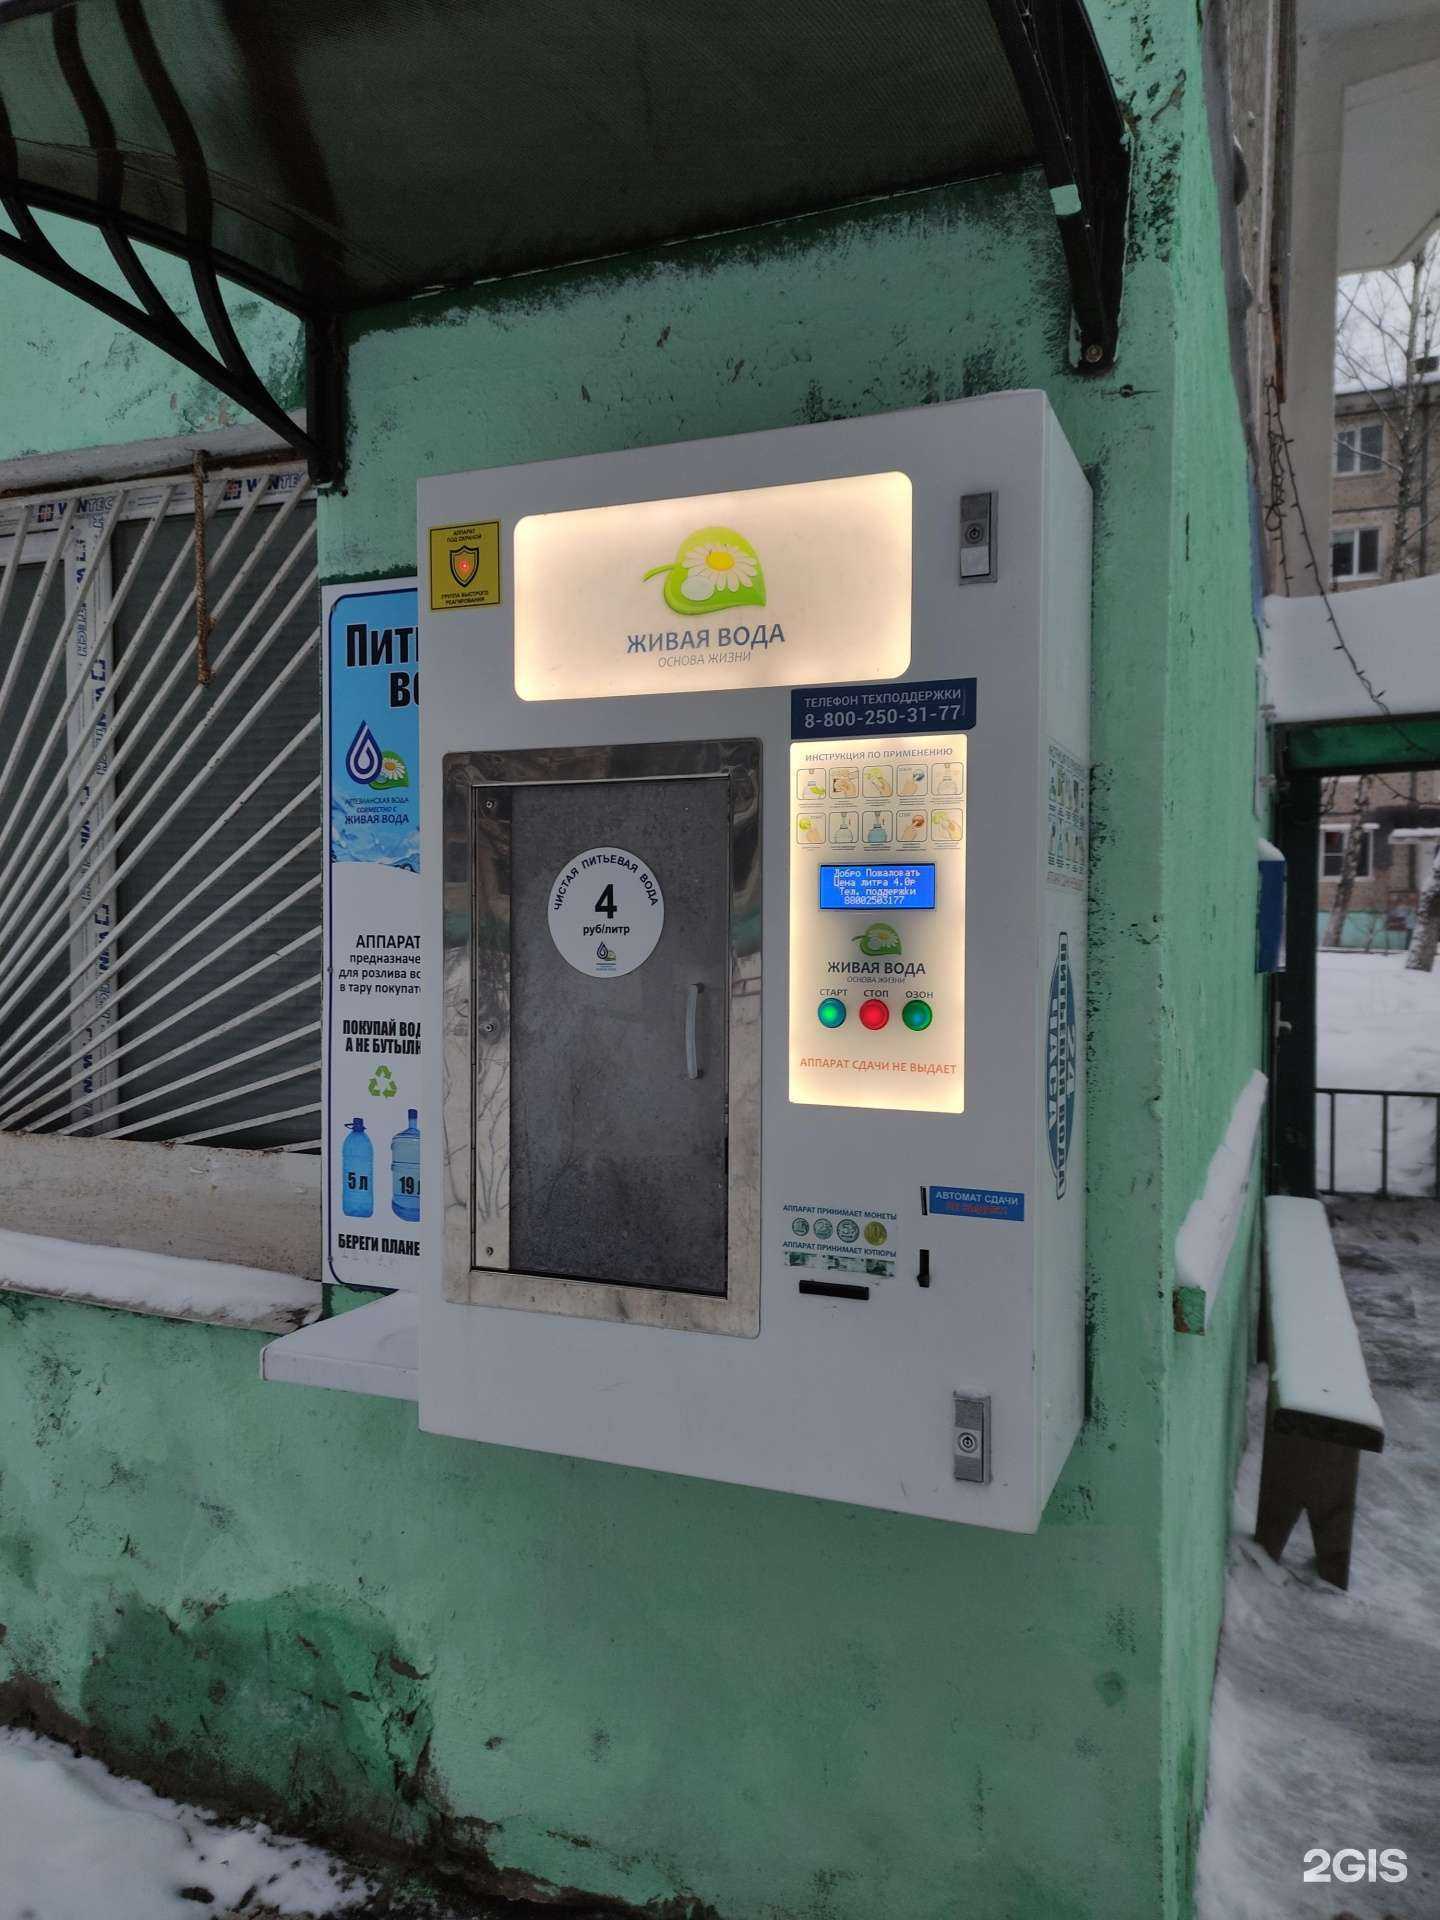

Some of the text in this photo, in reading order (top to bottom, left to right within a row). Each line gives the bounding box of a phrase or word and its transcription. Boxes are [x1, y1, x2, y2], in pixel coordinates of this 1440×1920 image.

[347, 624, 419, 667] Пит
[627, 623, 785, 653] ЖИВАЯ ВОДА
[658, 652, 751, 668] ОСНОВА ЖИЗНИ
[804, 689, 961, 708] ТЕЛЕФОН ТЕХПОДДЕРЖКИ
[804, 705, 960, 728] 8-800-250-31-77
[805, 747, 953, 761] ИНСТРУКЦИЯ ПО ПРИМЕНЕНИЮ
[345, 815, 409, 826] ЖИВАЯ ВОДА
[833, 869, 861, 877] Добро
[553, 854, 659, 910] ЧИСТАЯ ПИТЬЕВАЯ ВОДА
[833, 876, 856, 887] Цена
[840, 887, 916, 898] Тел. поддержки
[595, 884, 617, 919] 4
[844, 896, 905, 905] 88002503177
[583, 924, 630, 936] руб/литр
[356, 934, 421, 949] АППАРАТ
[339, 969, 359, 979] для
[362, 969, 407, 980] розлива
[828, 962, 926, 977] ЖИВАЯ ВОДА
[340, 984, 421, 996] в тару покупат
[820, 989, 847, 997] СТАРТ
[864, 990, 889, 998] СТОП
[905, 990, 933, 998] ОЗОН
[343, 1019, 396, 1036] ПОКУПАЙ
[345, 1037, 353, 1052] А
[356, 1038, 370, 1053] НЕ
[800, 1058, 956, 1074] АППАРАТ СДАЧИ НЕ ВЫДАЕТ
[348, 1172, 368, 1190] 5 л
[399, 1176, 414, 1194] 19
[936, 1191, 1019, 1205] АВТОМАТ СДАЧИ
[783, 1204, 897, 1220] АППАРАТ ПРИНИМАЕТ МОНЕТЫ
[338, 1233, 420, 1256] БЕРЕГИ ПЛАНЕ
[783, 1241, 815, 1249] АППАРАТ
[817, 1244, 862, 1255] ПРИНИМАЕТ
